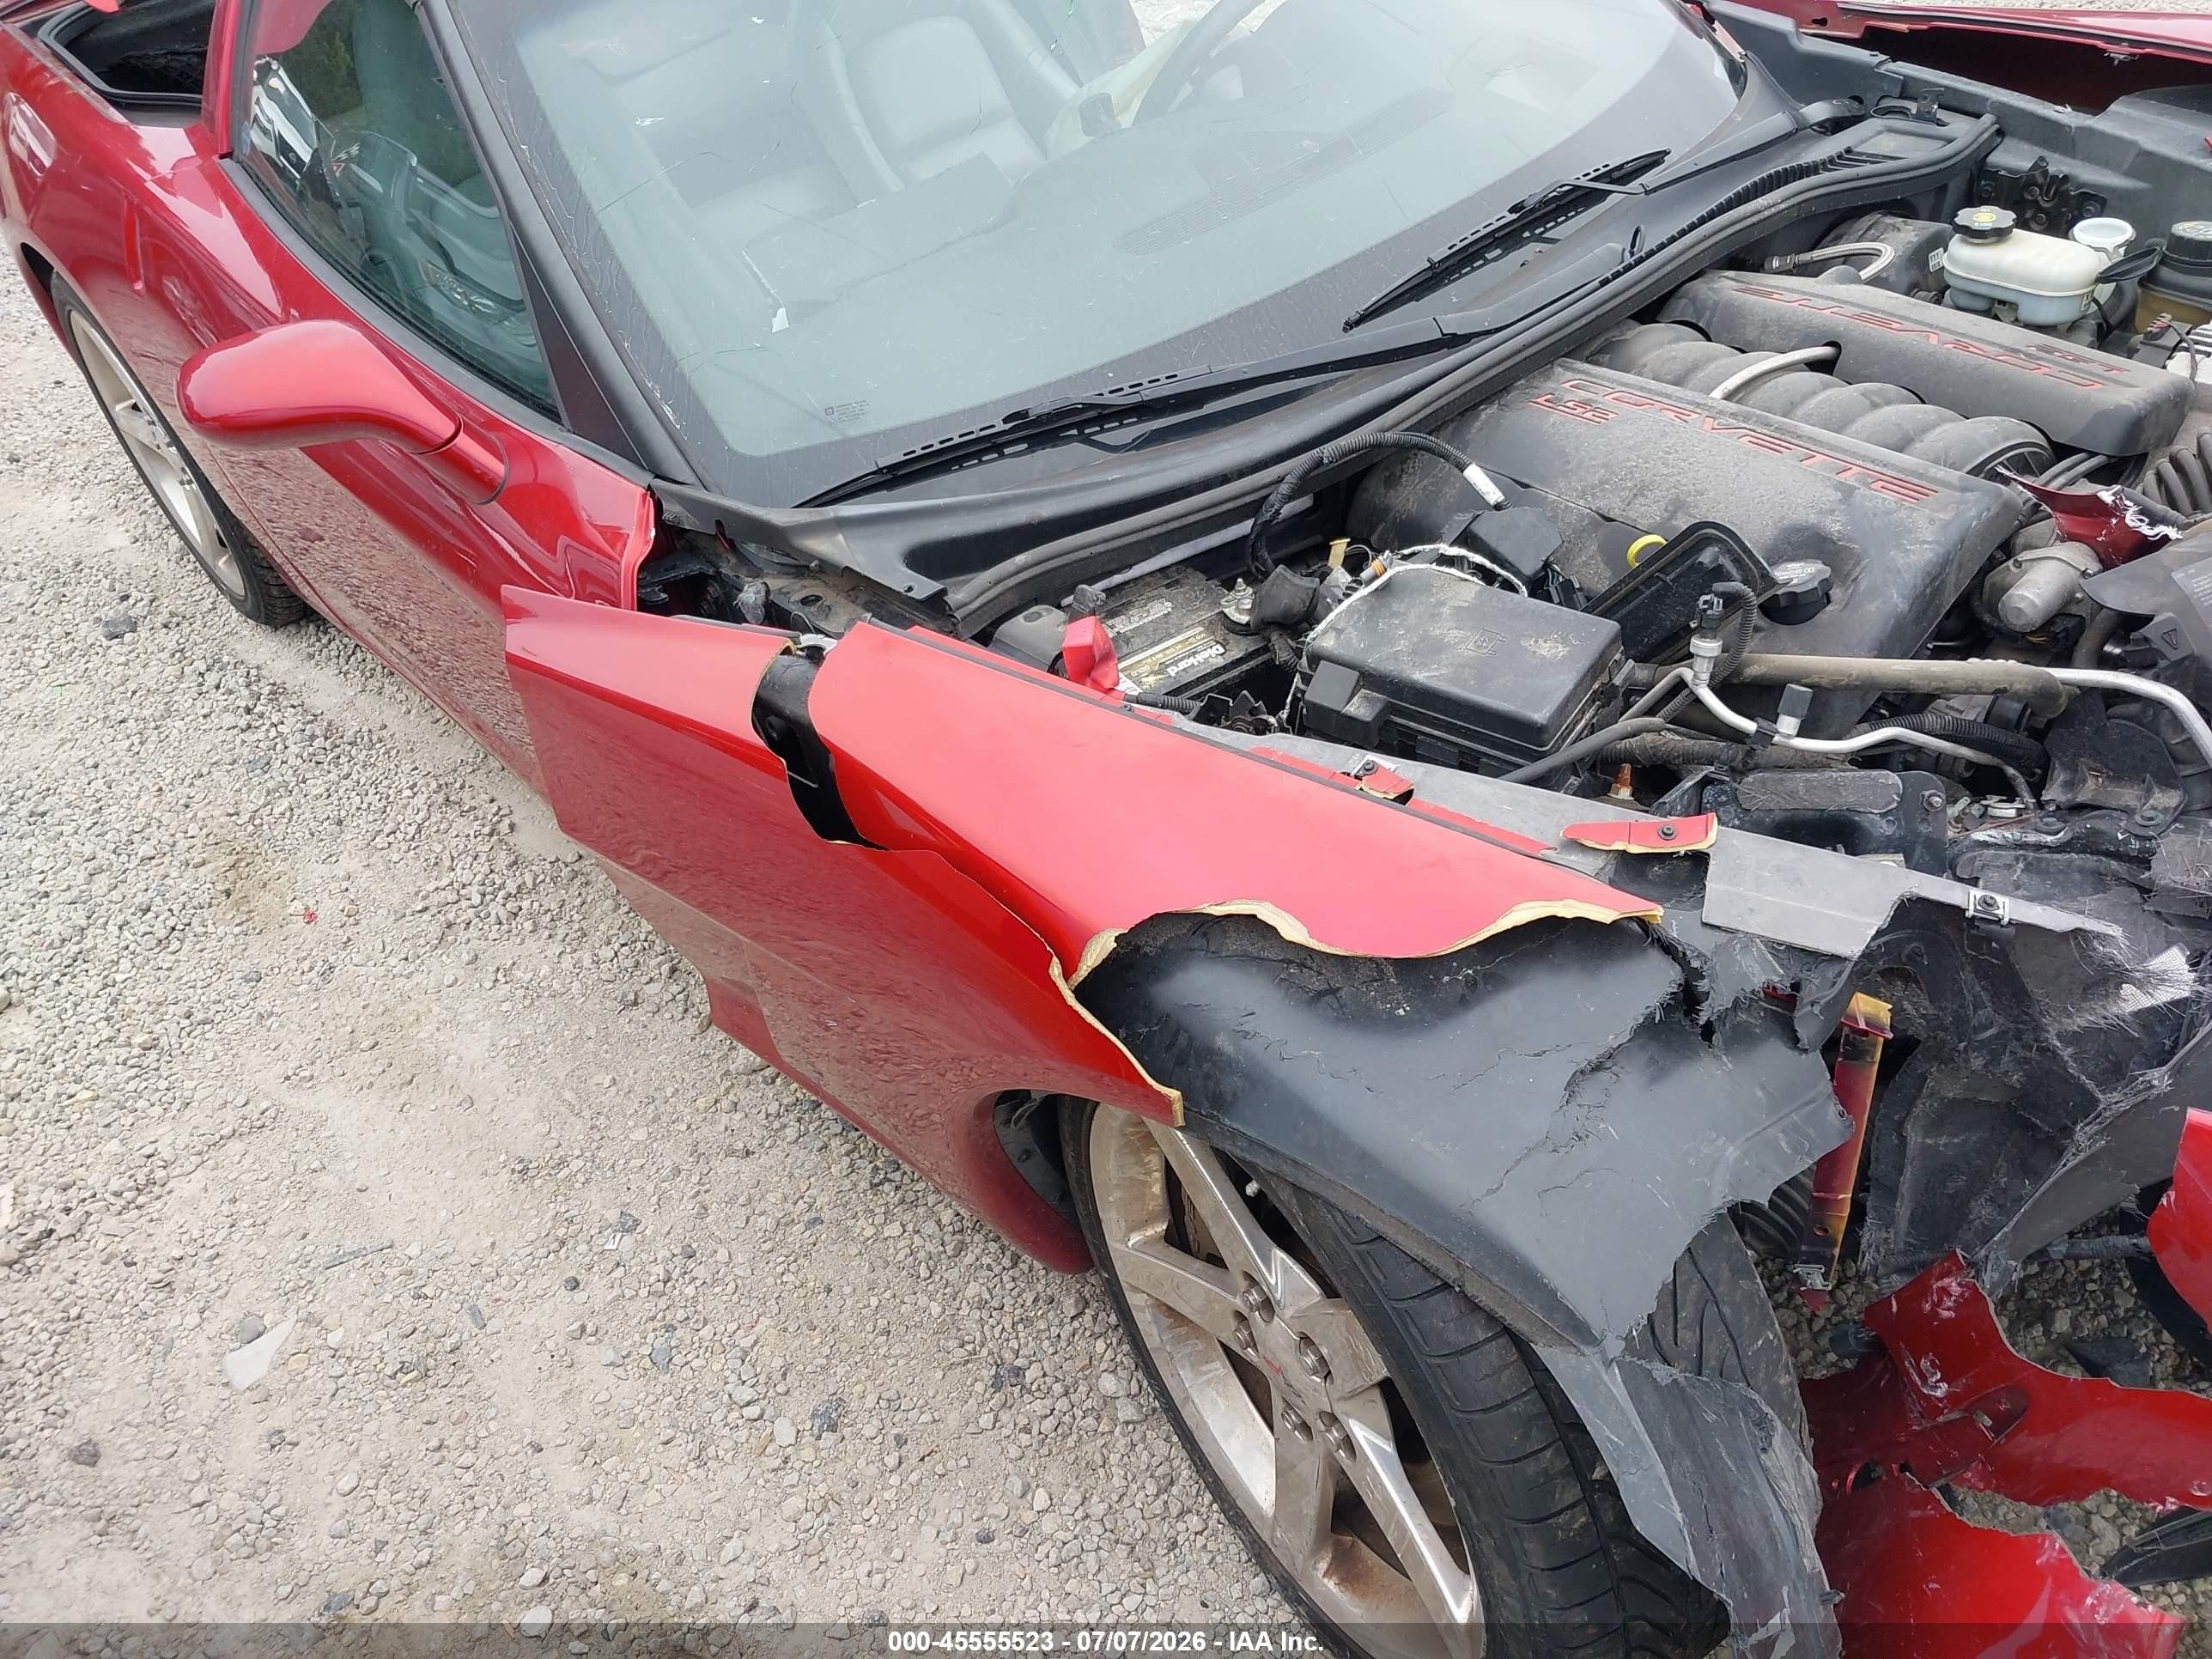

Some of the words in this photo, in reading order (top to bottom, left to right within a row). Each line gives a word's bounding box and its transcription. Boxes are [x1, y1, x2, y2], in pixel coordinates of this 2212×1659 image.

[1733, 286, 2106, 389] CORVETTE
[1527, 392, 1619, 425] LS2
[1561, 379, 1939, 503] CORVETTE
[1167, 642, 1226, 677] DieHard
